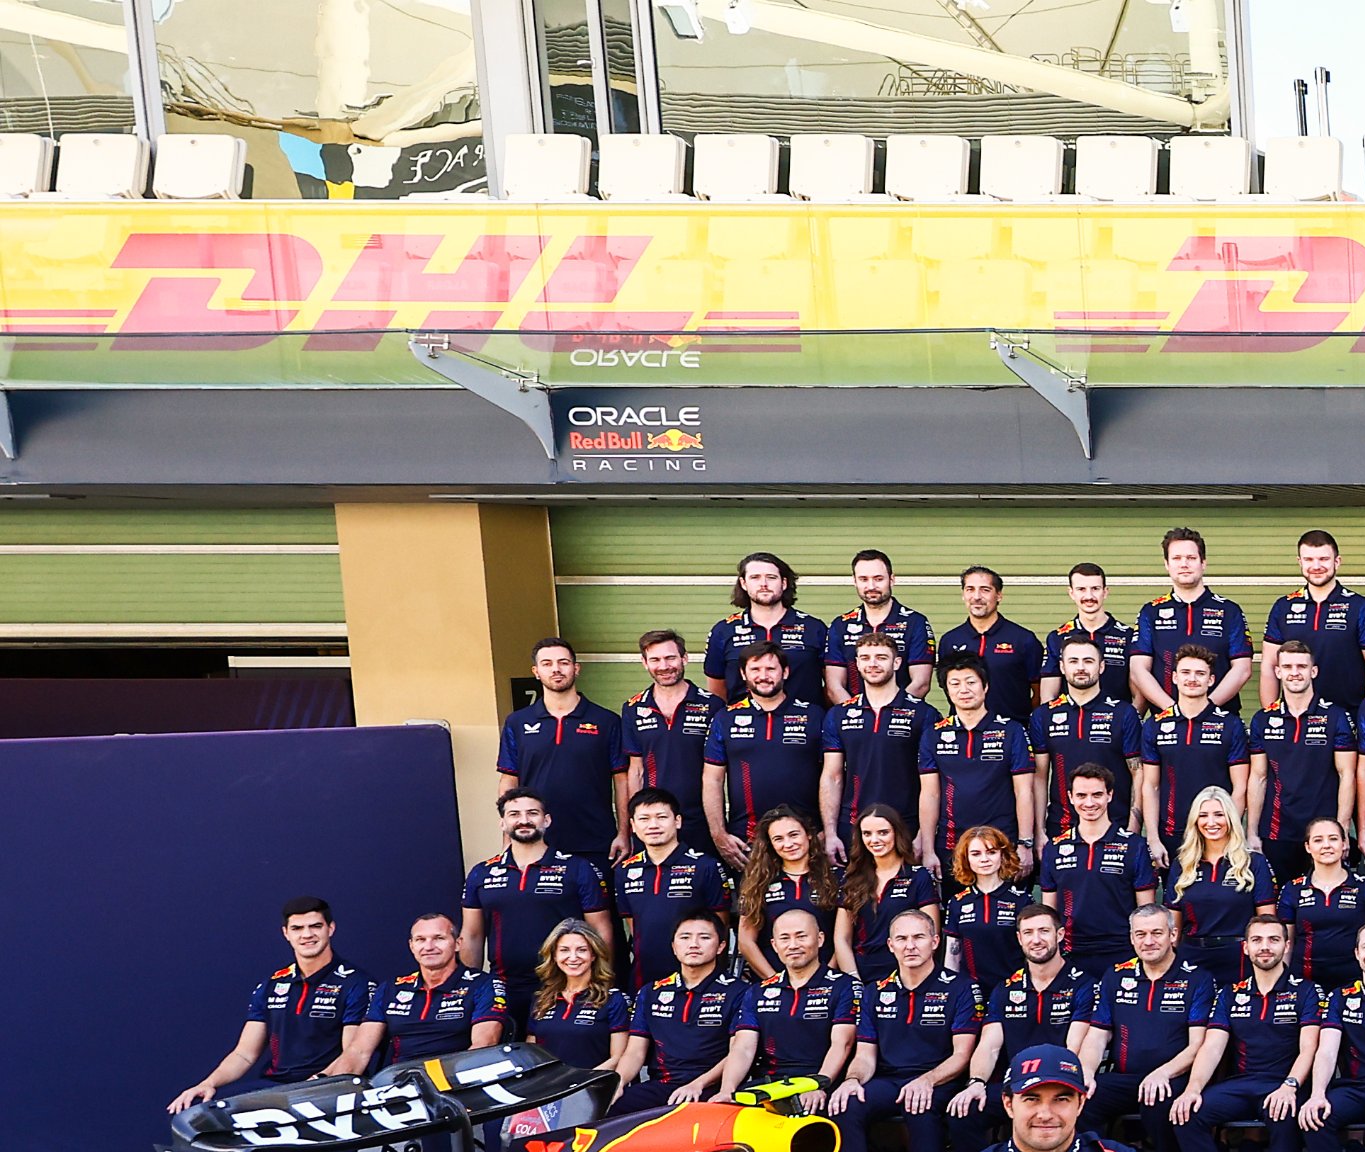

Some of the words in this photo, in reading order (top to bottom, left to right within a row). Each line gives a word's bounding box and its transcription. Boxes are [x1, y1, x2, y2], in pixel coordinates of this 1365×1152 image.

[109, 233, 697, 352] DHL
[568, 406, 701, 426] ORACLE
[573, 459, 706, 471] RACING
